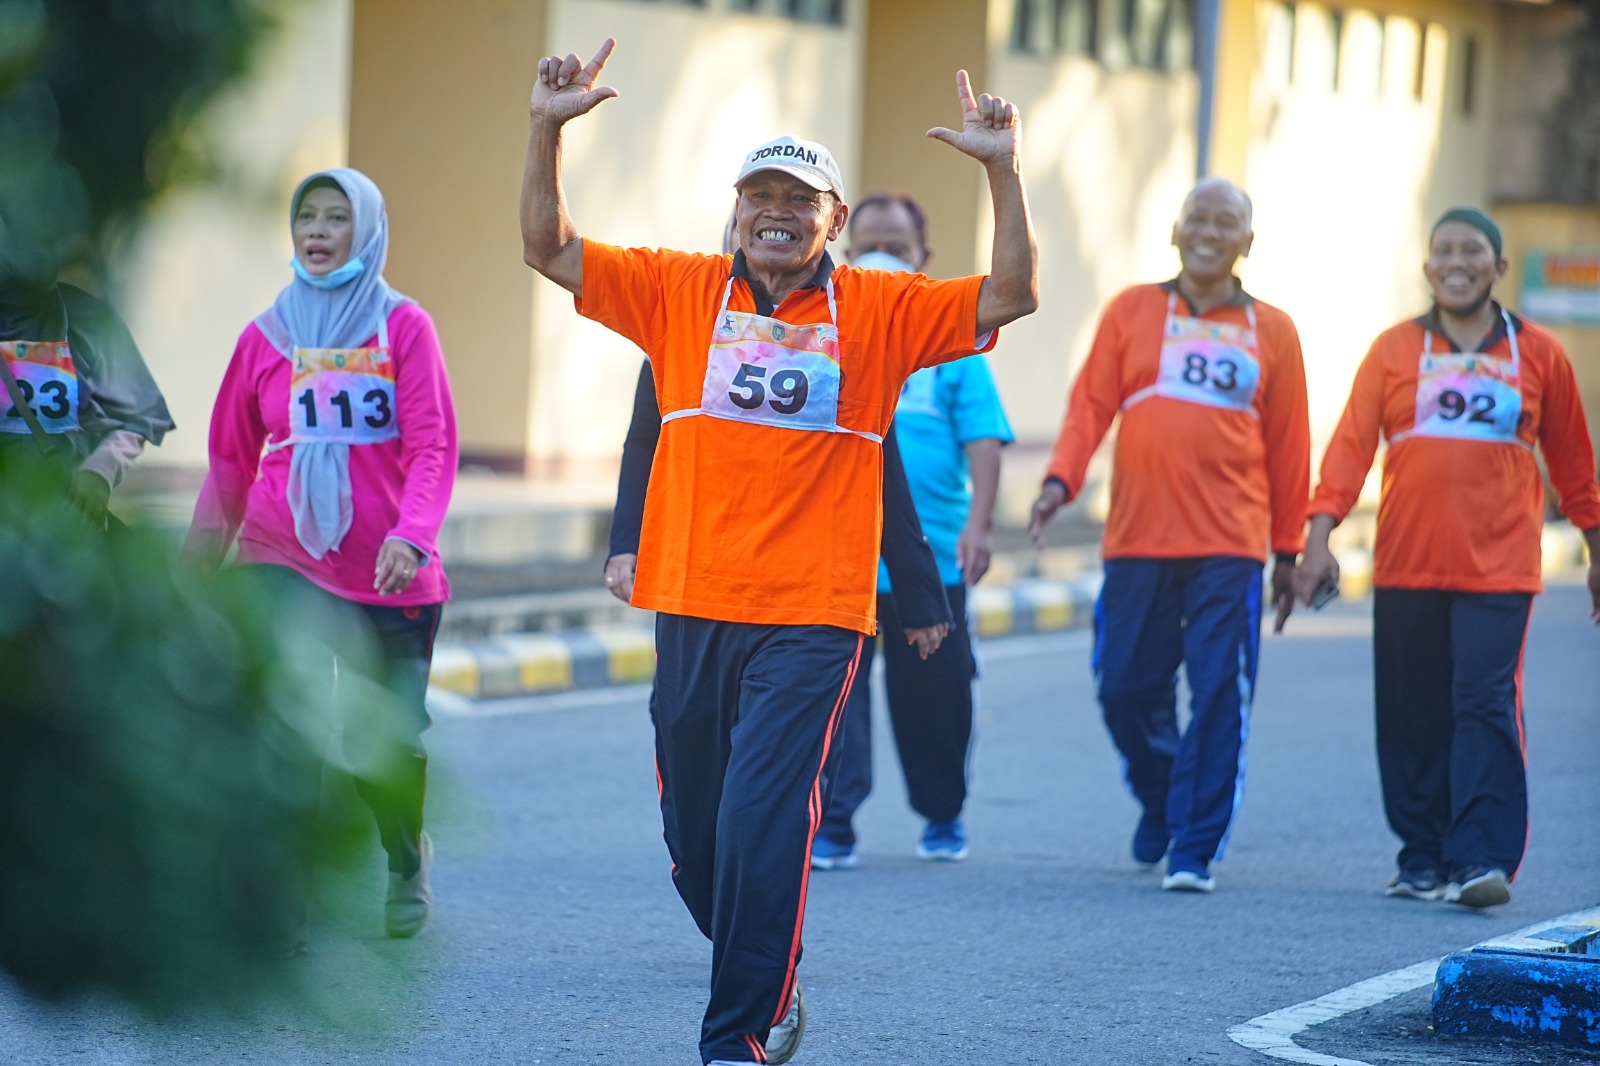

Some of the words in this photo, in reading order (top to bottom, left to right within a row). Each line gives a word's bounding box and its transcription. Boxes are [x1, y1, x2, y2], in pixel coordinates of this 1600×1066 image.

[752, 145, 817, 165] JORDAN
[728, 363, 808, 414] 59
[1183, 353, 1237, 390] 83
[299, 389, 391, 428] 113
[1438, 390, 1495, 424] 92
